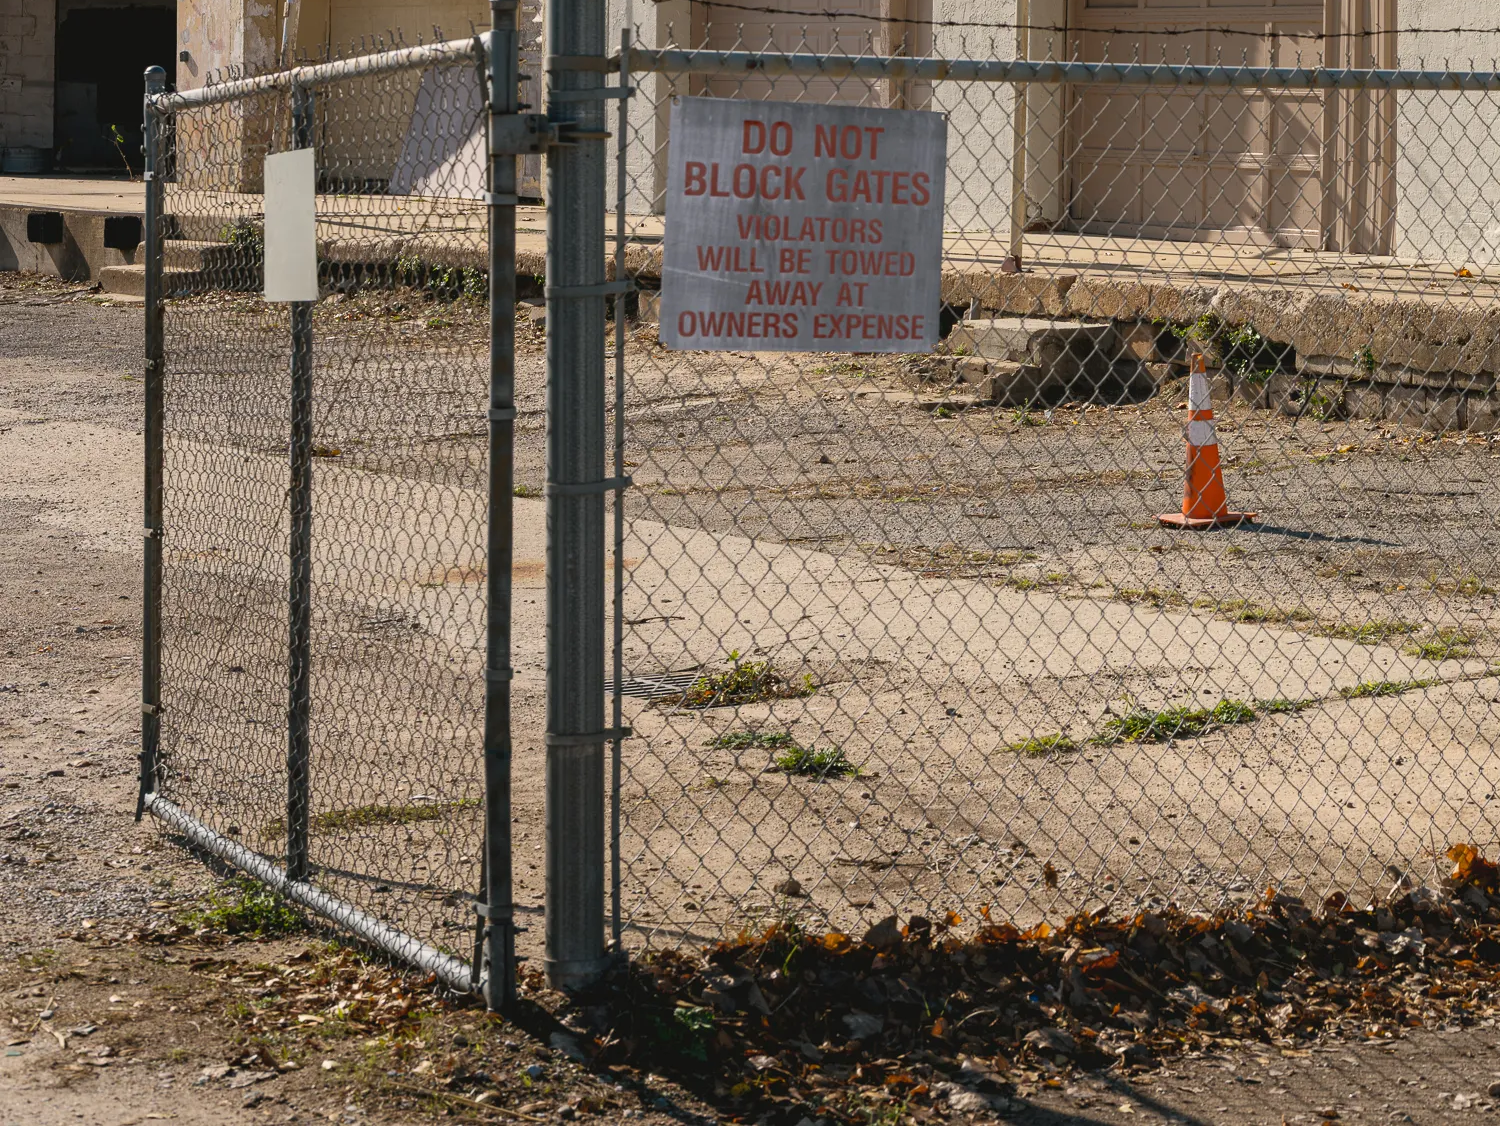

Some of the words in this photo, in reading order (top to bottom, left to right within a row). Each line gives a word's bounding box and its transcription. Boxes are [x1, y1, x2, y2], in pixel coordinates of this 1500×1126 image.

[742, 119, 793, 157] DO
[814, 123, 885, 161] NOT
[684, 161, 806, 201] BLOCK
[826, 168, 930, 207] GATES
[737, 214, 884, 244] VIOLATORS
[696, 245, 764, 273] WILL
[779, 247, 812, 274] BE
[825, 249, 916, 277] TOWED
[745, 279, 824, 306] AWAY
[836, 281, 869, 308] AT
[677, 310, 799, 339] OWNERS
[813, 313, 925, 341] EXPENSE
